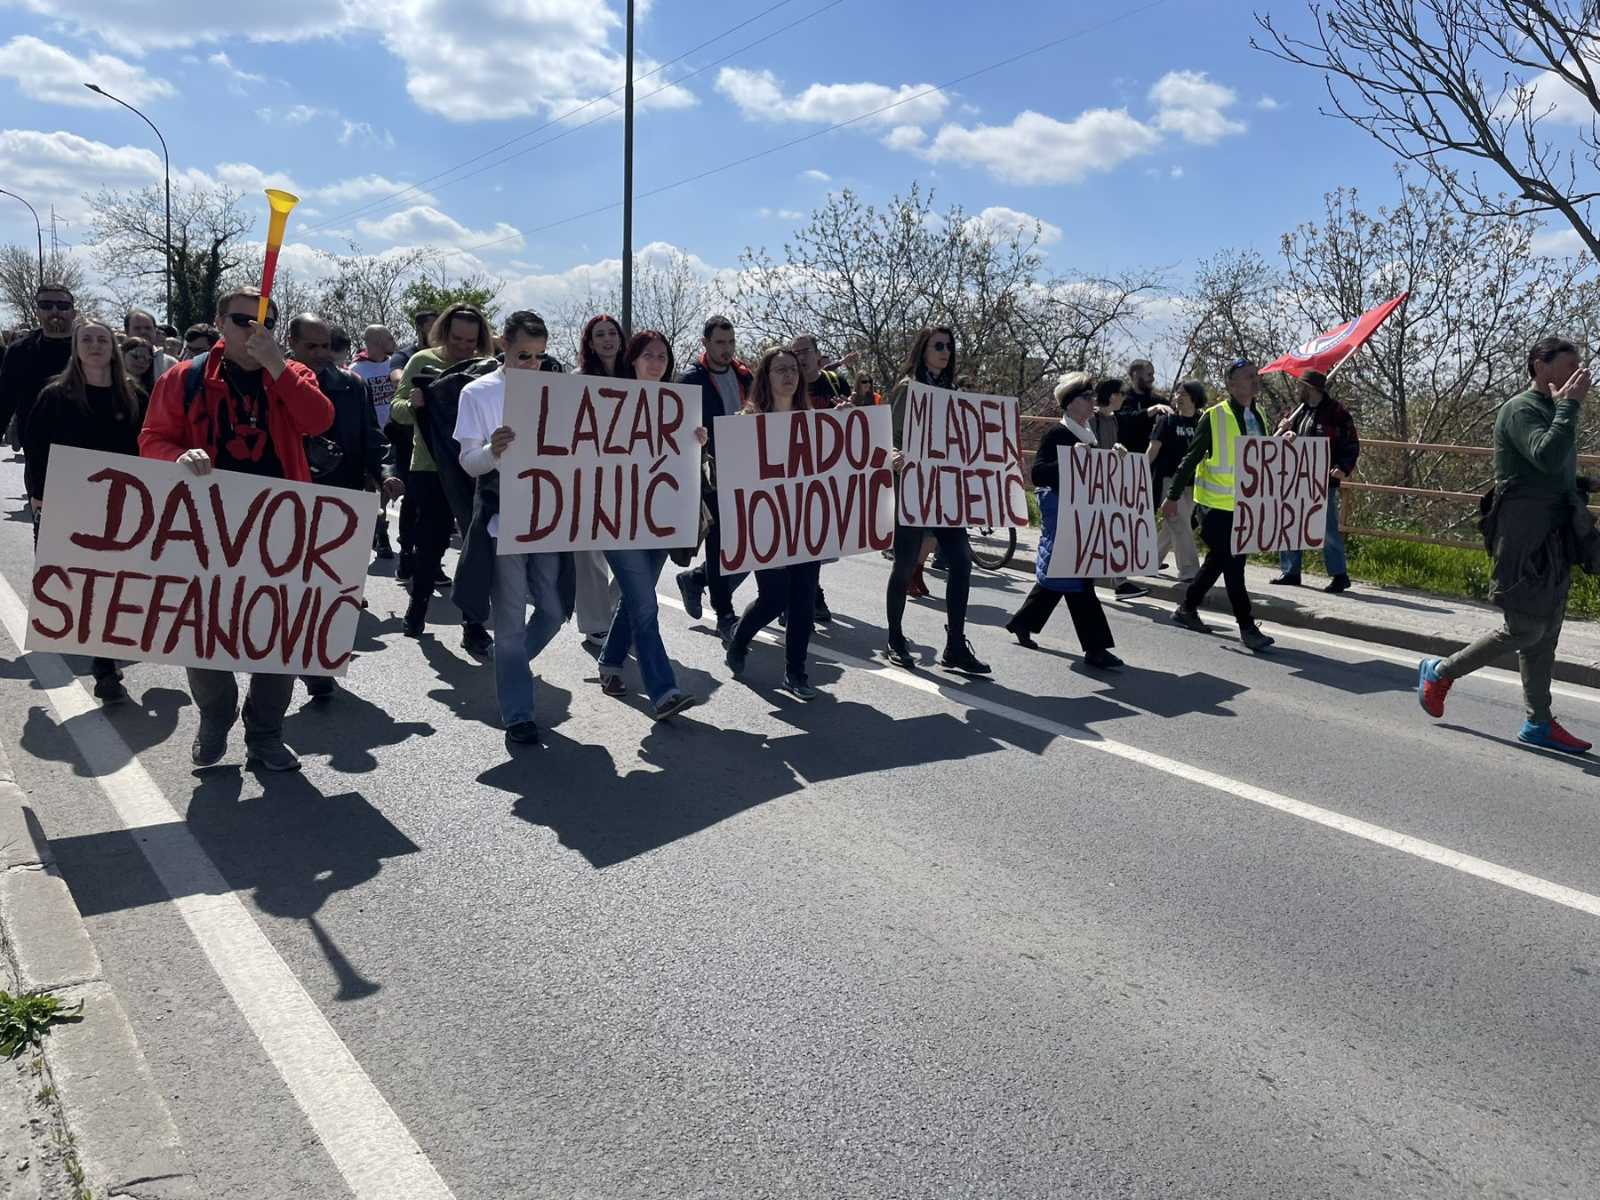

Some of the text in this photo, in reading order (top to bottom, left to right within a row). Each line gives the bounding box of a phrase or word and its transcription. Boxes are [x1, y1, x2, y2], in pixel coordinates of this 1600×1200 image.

[537, 385, 684, 457] LAZAR
[756, 409, 870, 480] LADO
[908, 390, 1024, 468] MLADEN
[515, 455, 679, 542] DINIĆ
[901, 461, 1029, 528] CVIJETIĆ
[1070, 446, 1150, 510] MARIJA
[1241, 438, 1329, 502] SRĐAN
[70, 467, 358, 584] DAVOR
[720, 446, 893, 571] JOVOVIĆ
[1074, 502, 1149, 576] VASIĆ
[1234, 495, 1323, 552] ĐURIĆ
[32, 565, 362, 670] STEFANOVIĆ
